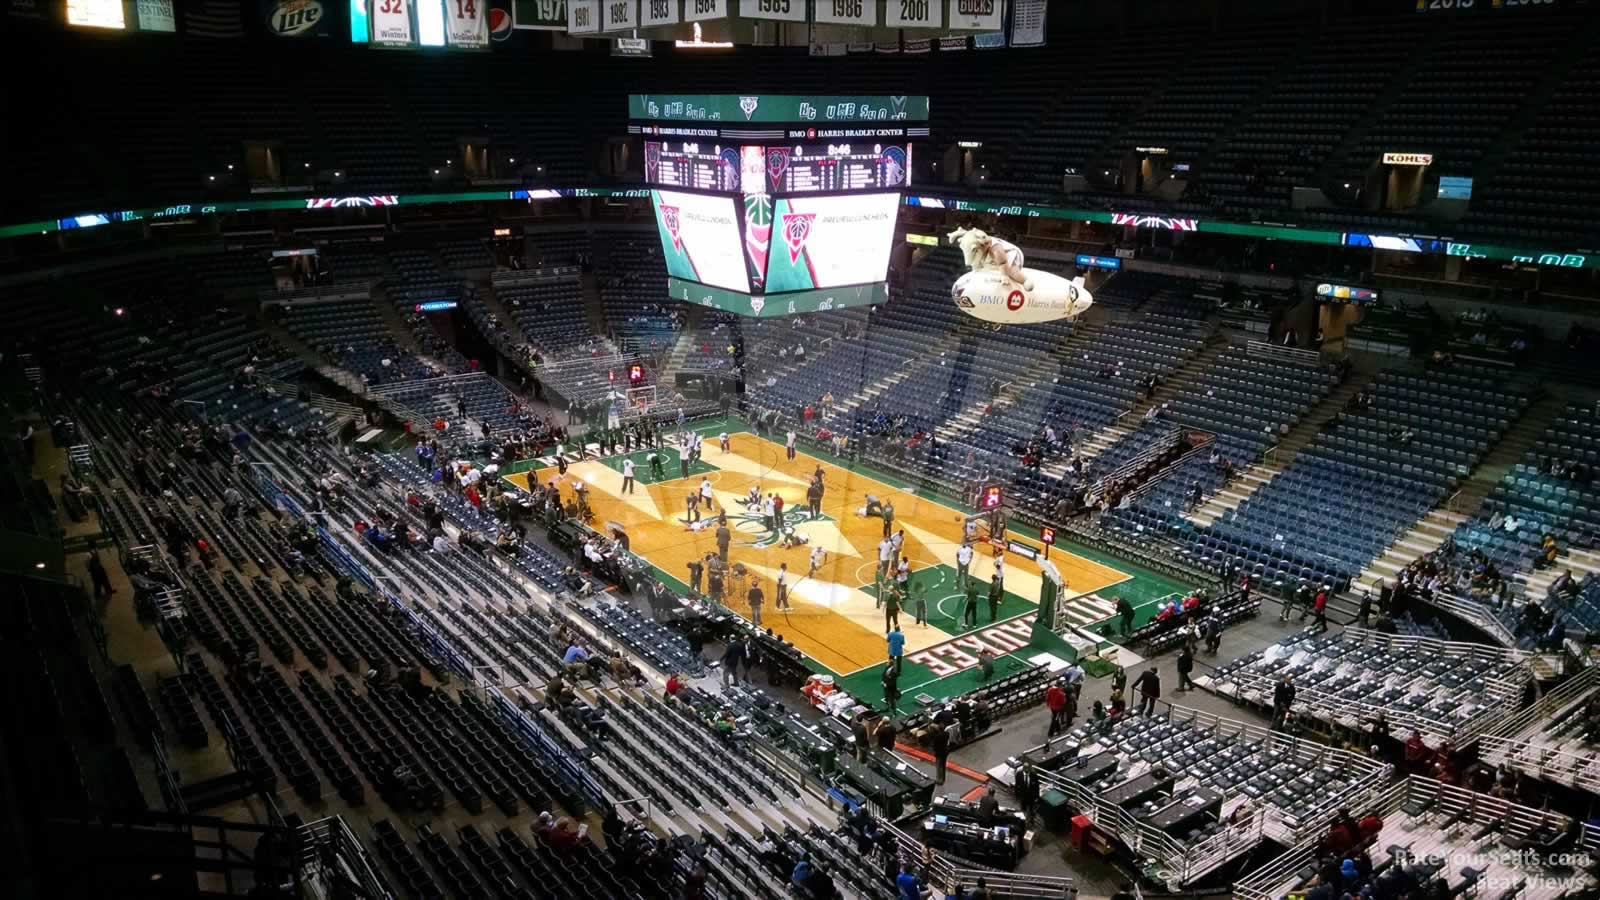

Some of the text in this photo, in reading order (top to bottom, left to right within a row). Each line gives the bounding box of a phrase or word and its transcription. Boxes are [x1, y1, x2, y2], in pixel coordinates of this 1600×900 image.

[139, 7, 173, 18] SENTINEL
[379, 0, 402, 14] 32
[456, 0, 476, 20] 14
[650, 0, 669, 19] 1983
[832, 0, 863, 18] 1986
[901, 0, 929, 21] 2001
[959, 0, 994, 13] BUCKS
[279, 7, 319, 32] Lite
[575, 7, 590, 27] 1981
[610, 3, 629, 24] 1982
[381, 30, 408, 39] Winters
[659, 127, 676, 135] HARRIS
[676, 128, 697, 136] BRADLEY
[697, 129, 718, 137] CENTER
[789, 130, 806, 138] BMO
[818, 129, 844, 137] HARRIS
[845, 129, 876, 137] BRADLEY
[828, 144, 851, 155] 8:46
[1387, 154, 1430, 164] KOHL'S
[979, 295, 1004, 305] BMO
[1028, 298, 1049, 308] Harris
